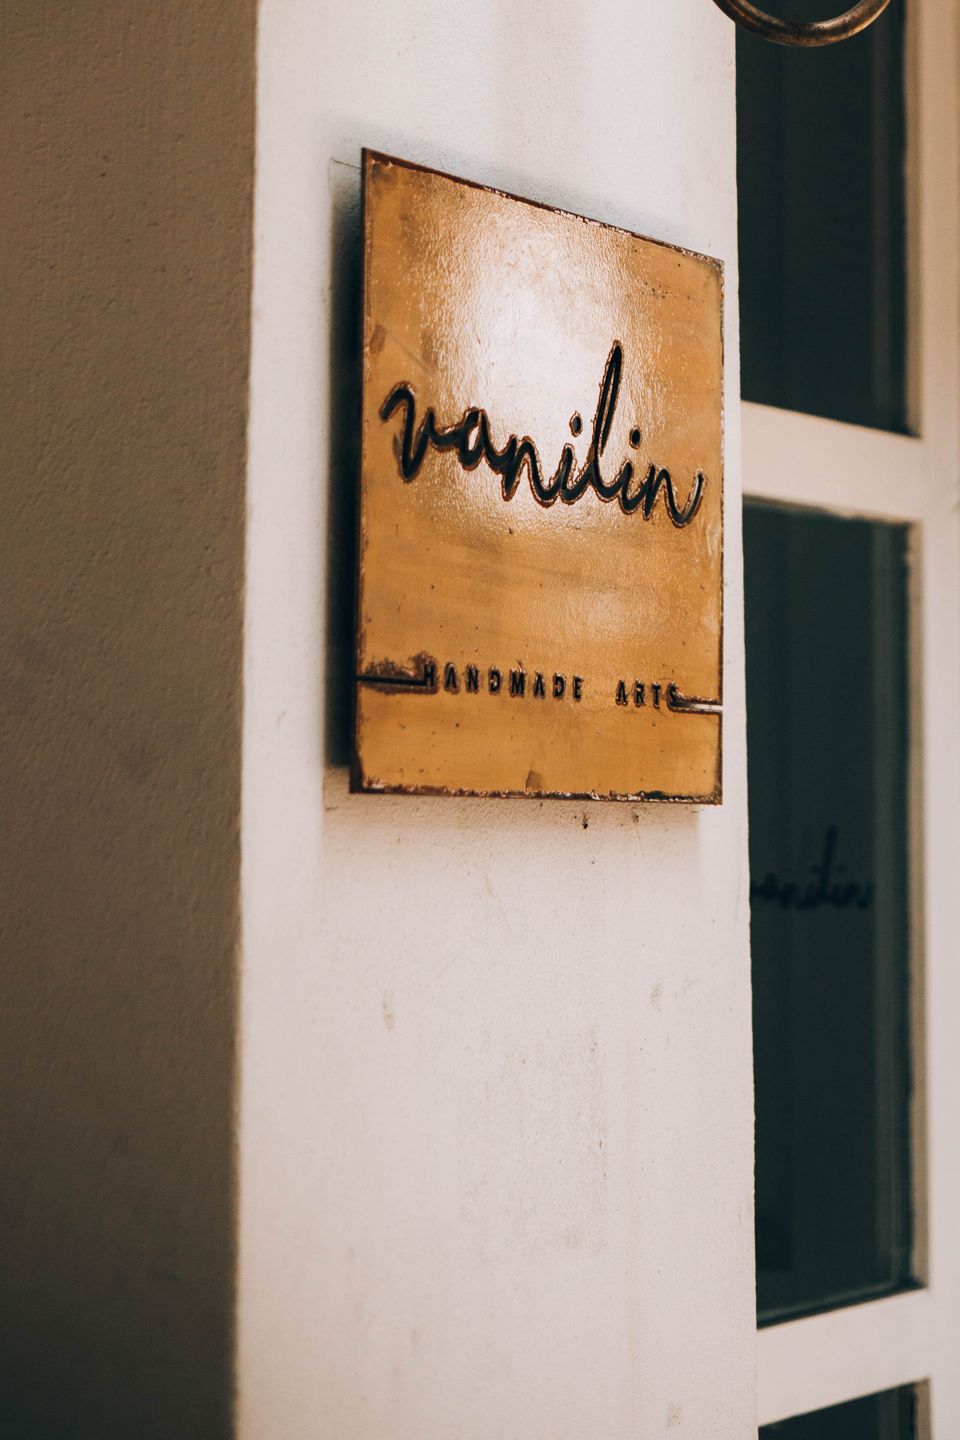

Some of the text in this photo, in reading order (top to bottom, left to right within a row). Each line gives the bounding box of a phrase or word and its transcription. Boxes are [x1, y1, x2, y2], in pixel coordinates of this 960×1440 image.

[379, 338, 706, 528] vanilin
[423, 661, 679, 709] HANDMADE ARTS
